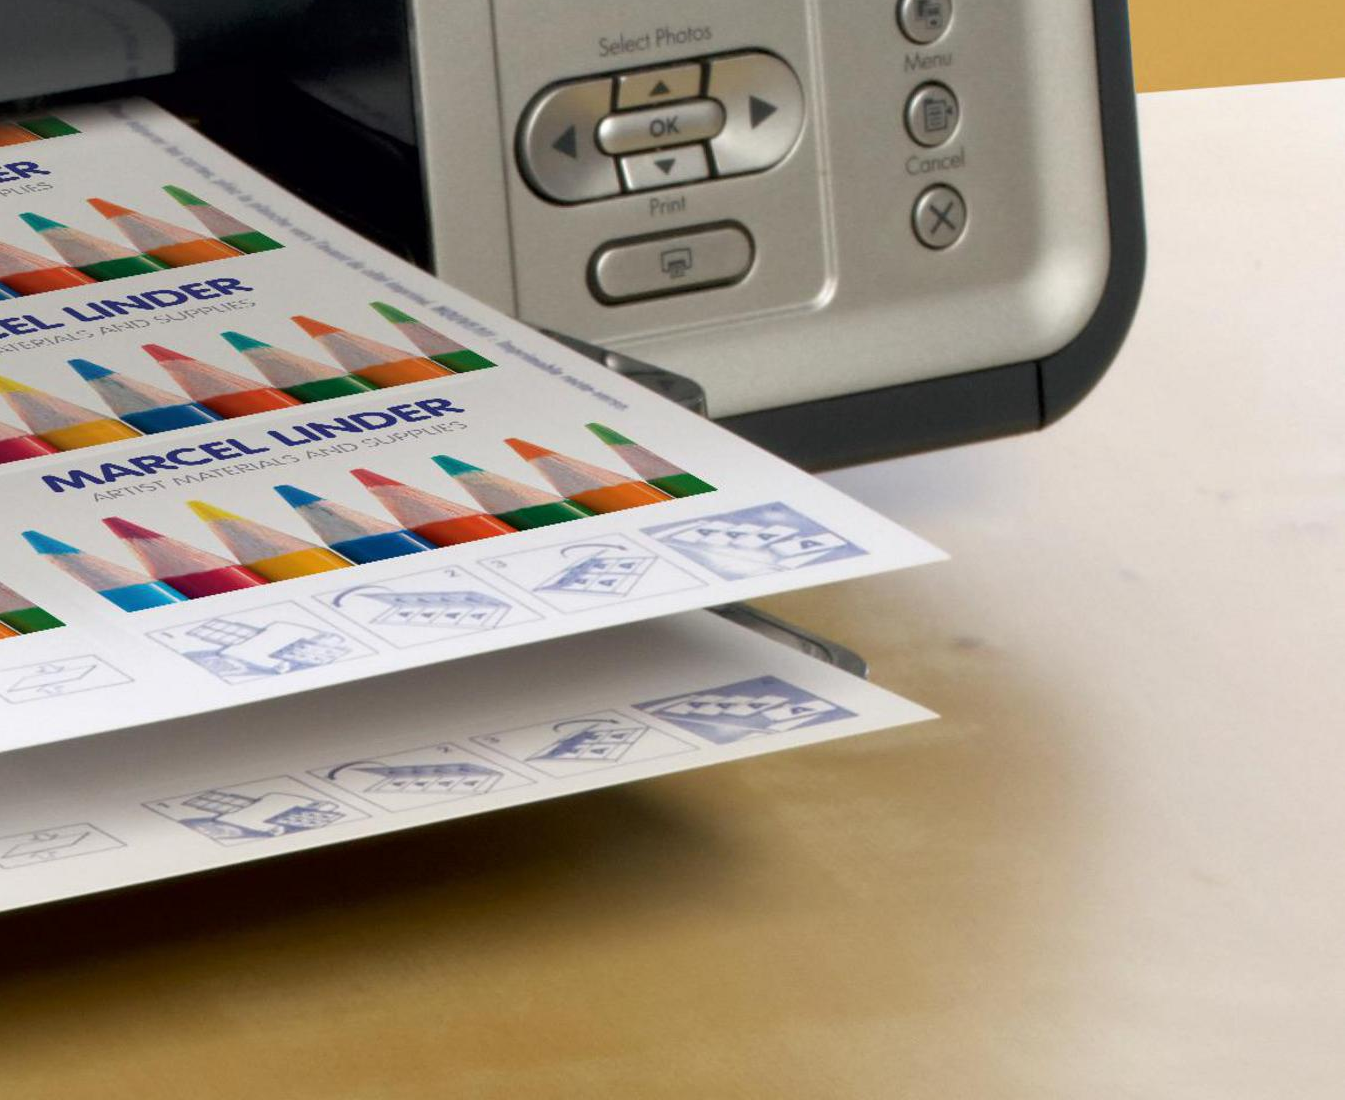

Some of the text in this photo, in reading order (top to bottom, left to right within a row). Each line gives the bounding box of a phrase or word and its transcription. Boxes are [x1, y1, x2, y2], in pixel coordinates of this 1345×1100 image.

[598, 24, 713, 57] Select Photos
[905, 53, 952, 72] Menu
[649, 116, 679, 137] OK
[905, 147, 965, 175] Cancel
[649, 196, 686, 216] Print
[62, 278, 253, 322] LINDER
[99, 319, 150, 335] AND
[153, 299, 256, 324] SUPPLIES
[41, 398, 465, 492] MARCEL LINDER
[94, 421, 467, 502] ARTIST MATERIALS AND SUPPLIES
